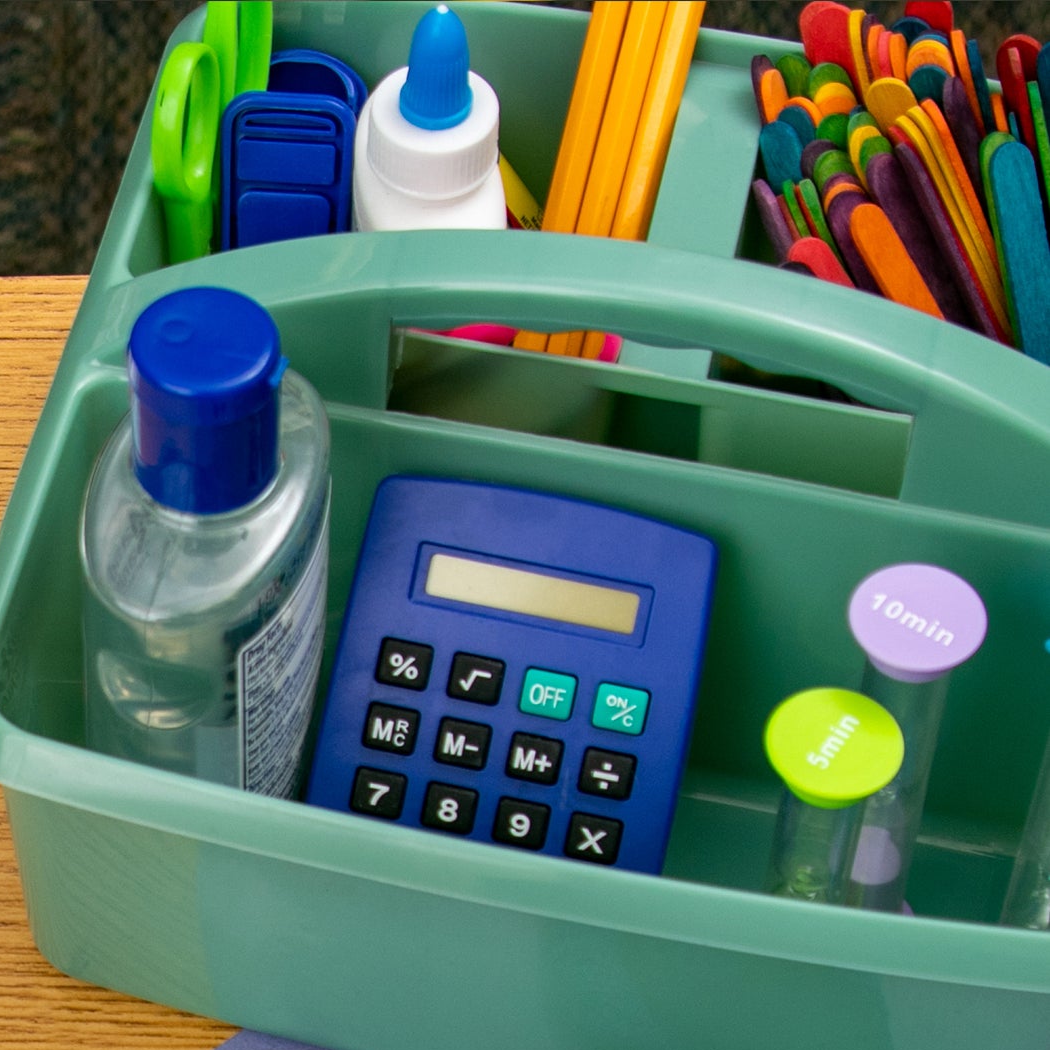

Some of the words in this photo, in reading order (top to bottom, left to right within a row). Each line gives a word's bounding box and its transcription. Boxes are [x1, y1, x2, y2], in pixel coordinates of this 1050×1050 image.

[870, 593, 955, 647] 10min
[529, 683, 567, 709] OFF
[805, 713, 861, 770] 5min
[512, 747, 553, 774] M+
[367, 782, 391, 807] 7
[436, 798, 459, 823] 8
[508, 813, 531, 838] 9
